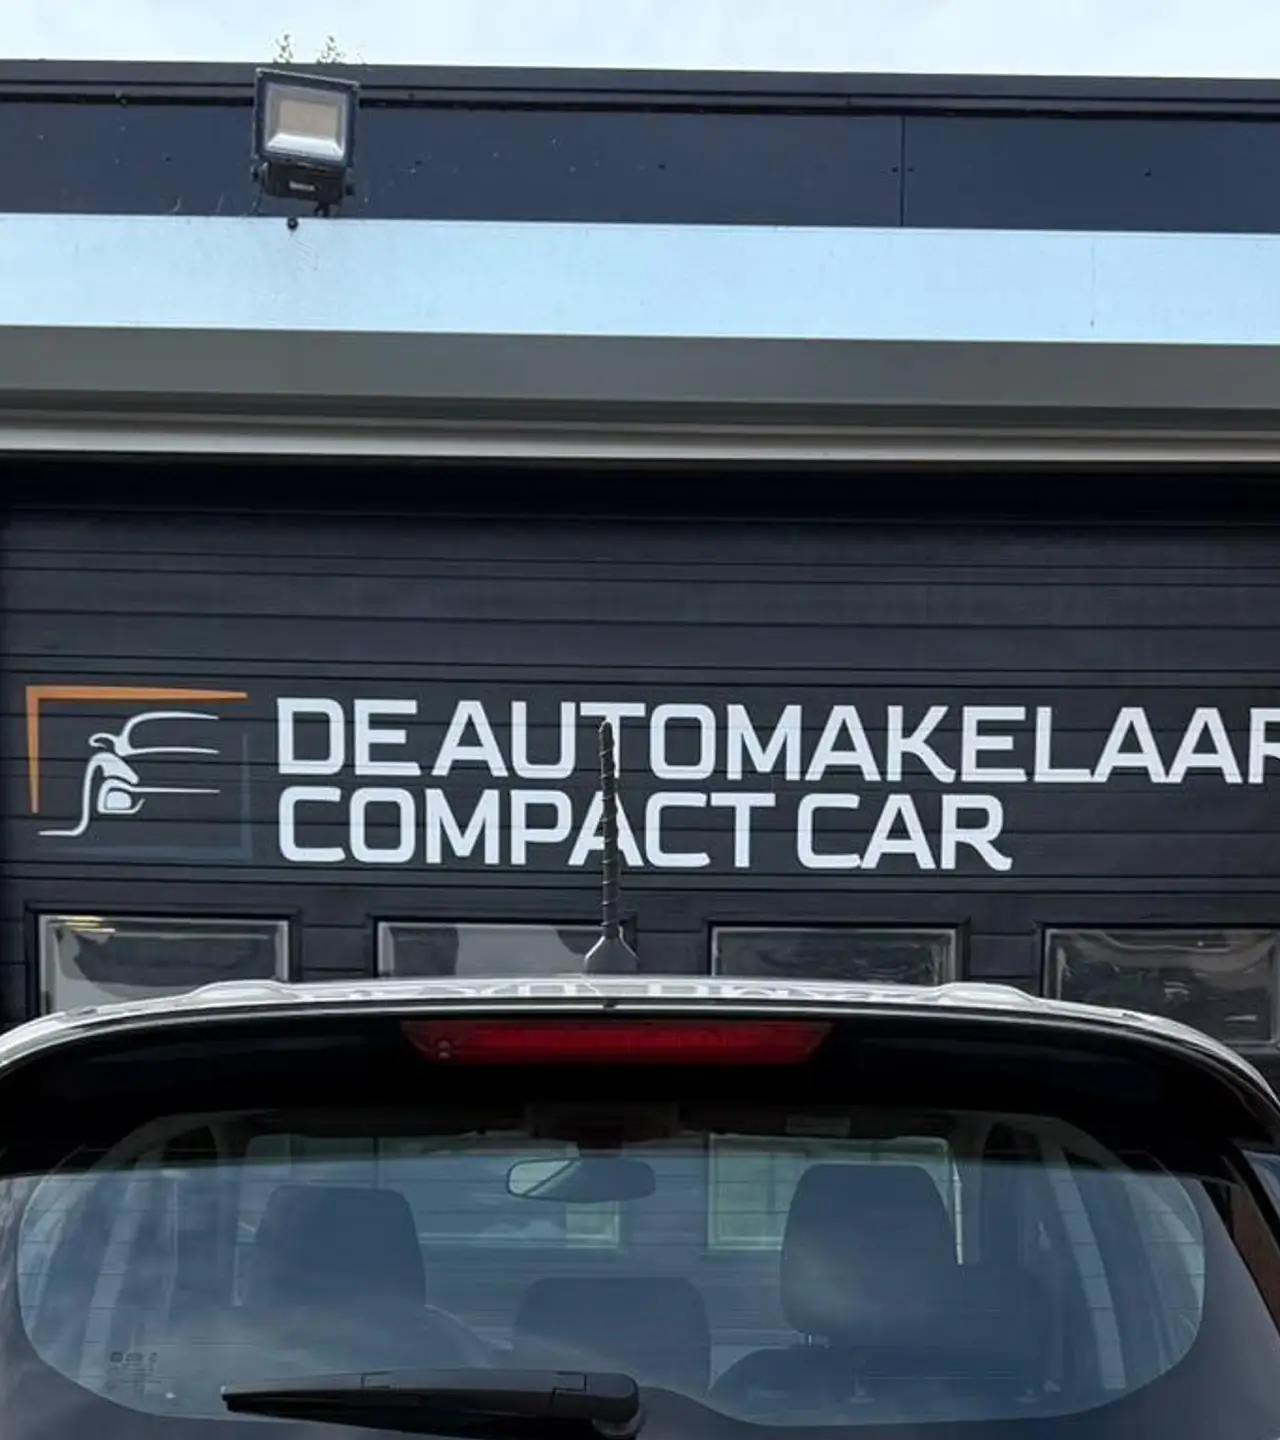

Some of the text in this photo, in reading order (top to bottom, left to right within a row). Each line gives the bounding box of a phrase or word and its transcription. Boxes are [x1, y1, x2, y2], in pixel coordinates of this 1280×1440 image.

[277, 698, 421, 777] DE
[278, 786, 1014, 872] COMPACT CAR
